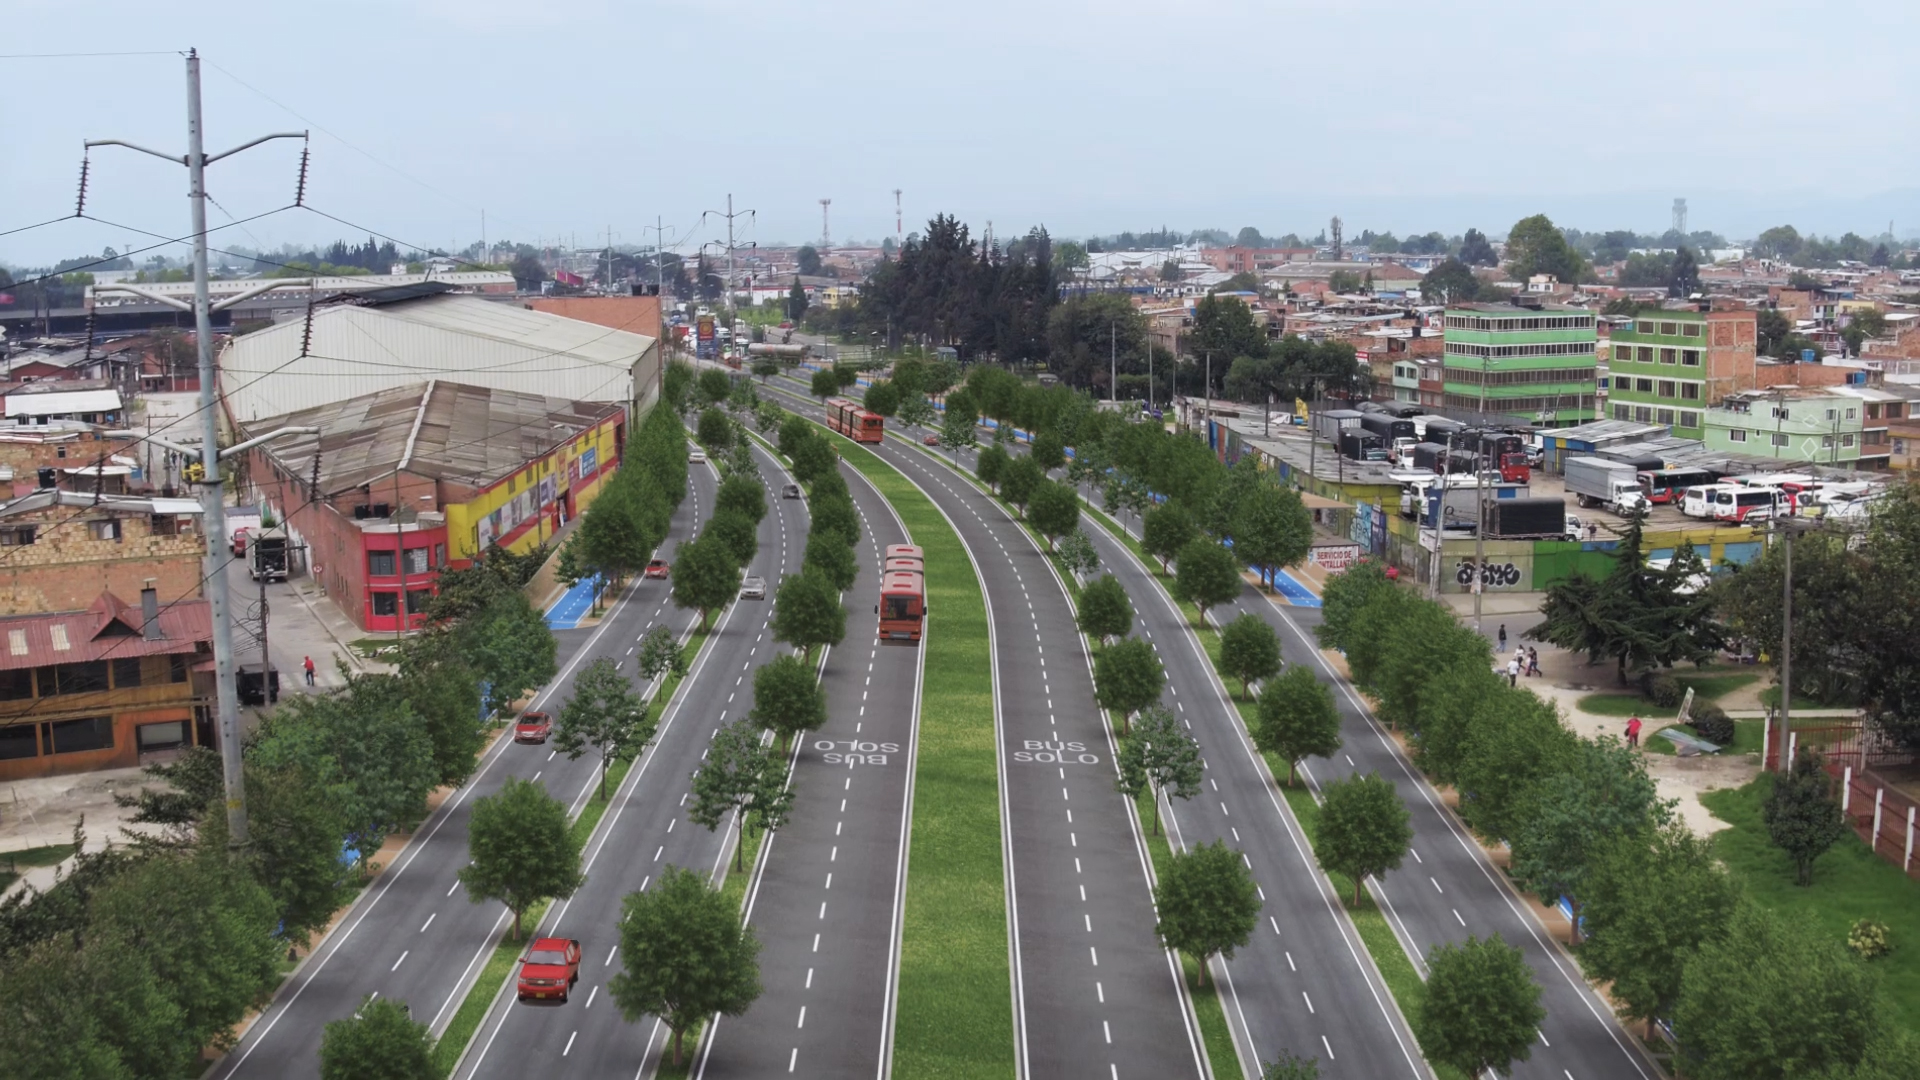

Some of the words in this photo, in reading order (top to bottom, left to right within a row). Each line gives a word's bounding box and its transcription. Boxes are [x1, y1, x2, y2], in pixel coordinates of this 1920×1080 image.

[1317, 550, 1343, 559] SERVICIO
[1344, 550, 1352, 559] DE
[814, 740, 900, 753] SOLO
[1023, 740, 1087, 752] BUS
[823, 753, 887, 765] BUS
[1013, 751, 1099, 765] SOLO
